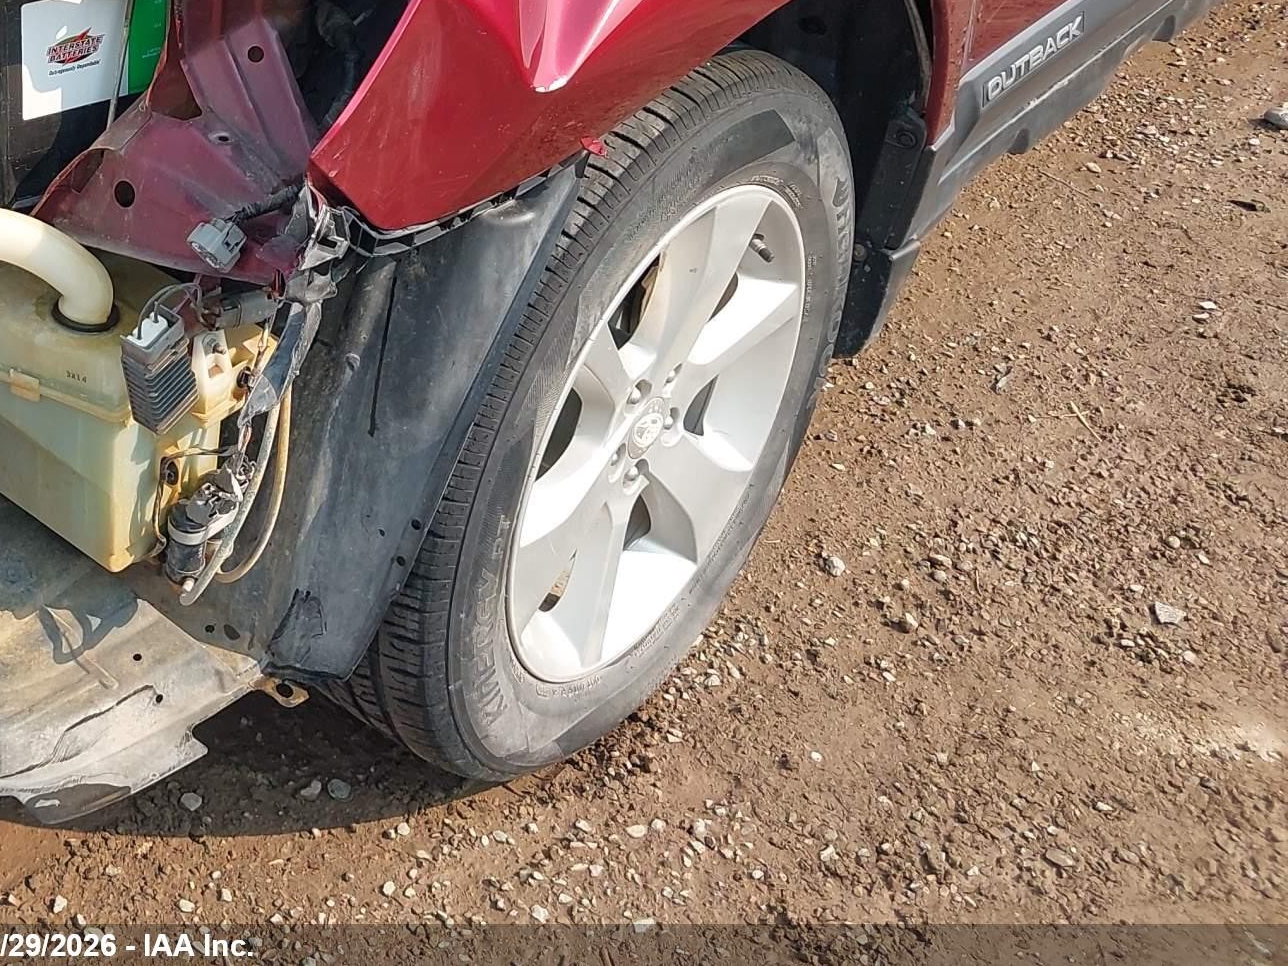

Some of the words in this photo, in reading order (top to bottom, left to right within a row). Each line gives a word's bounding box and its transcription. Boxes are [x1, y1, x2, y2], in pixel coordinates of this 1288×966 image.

[47, 35, 105, 55] INTERSTATE
[48, 45, 99, 63] BATTERIES
[987, 16, 1083, 100] OUTBACK
[472, 569, 508, 726] KINERGY
